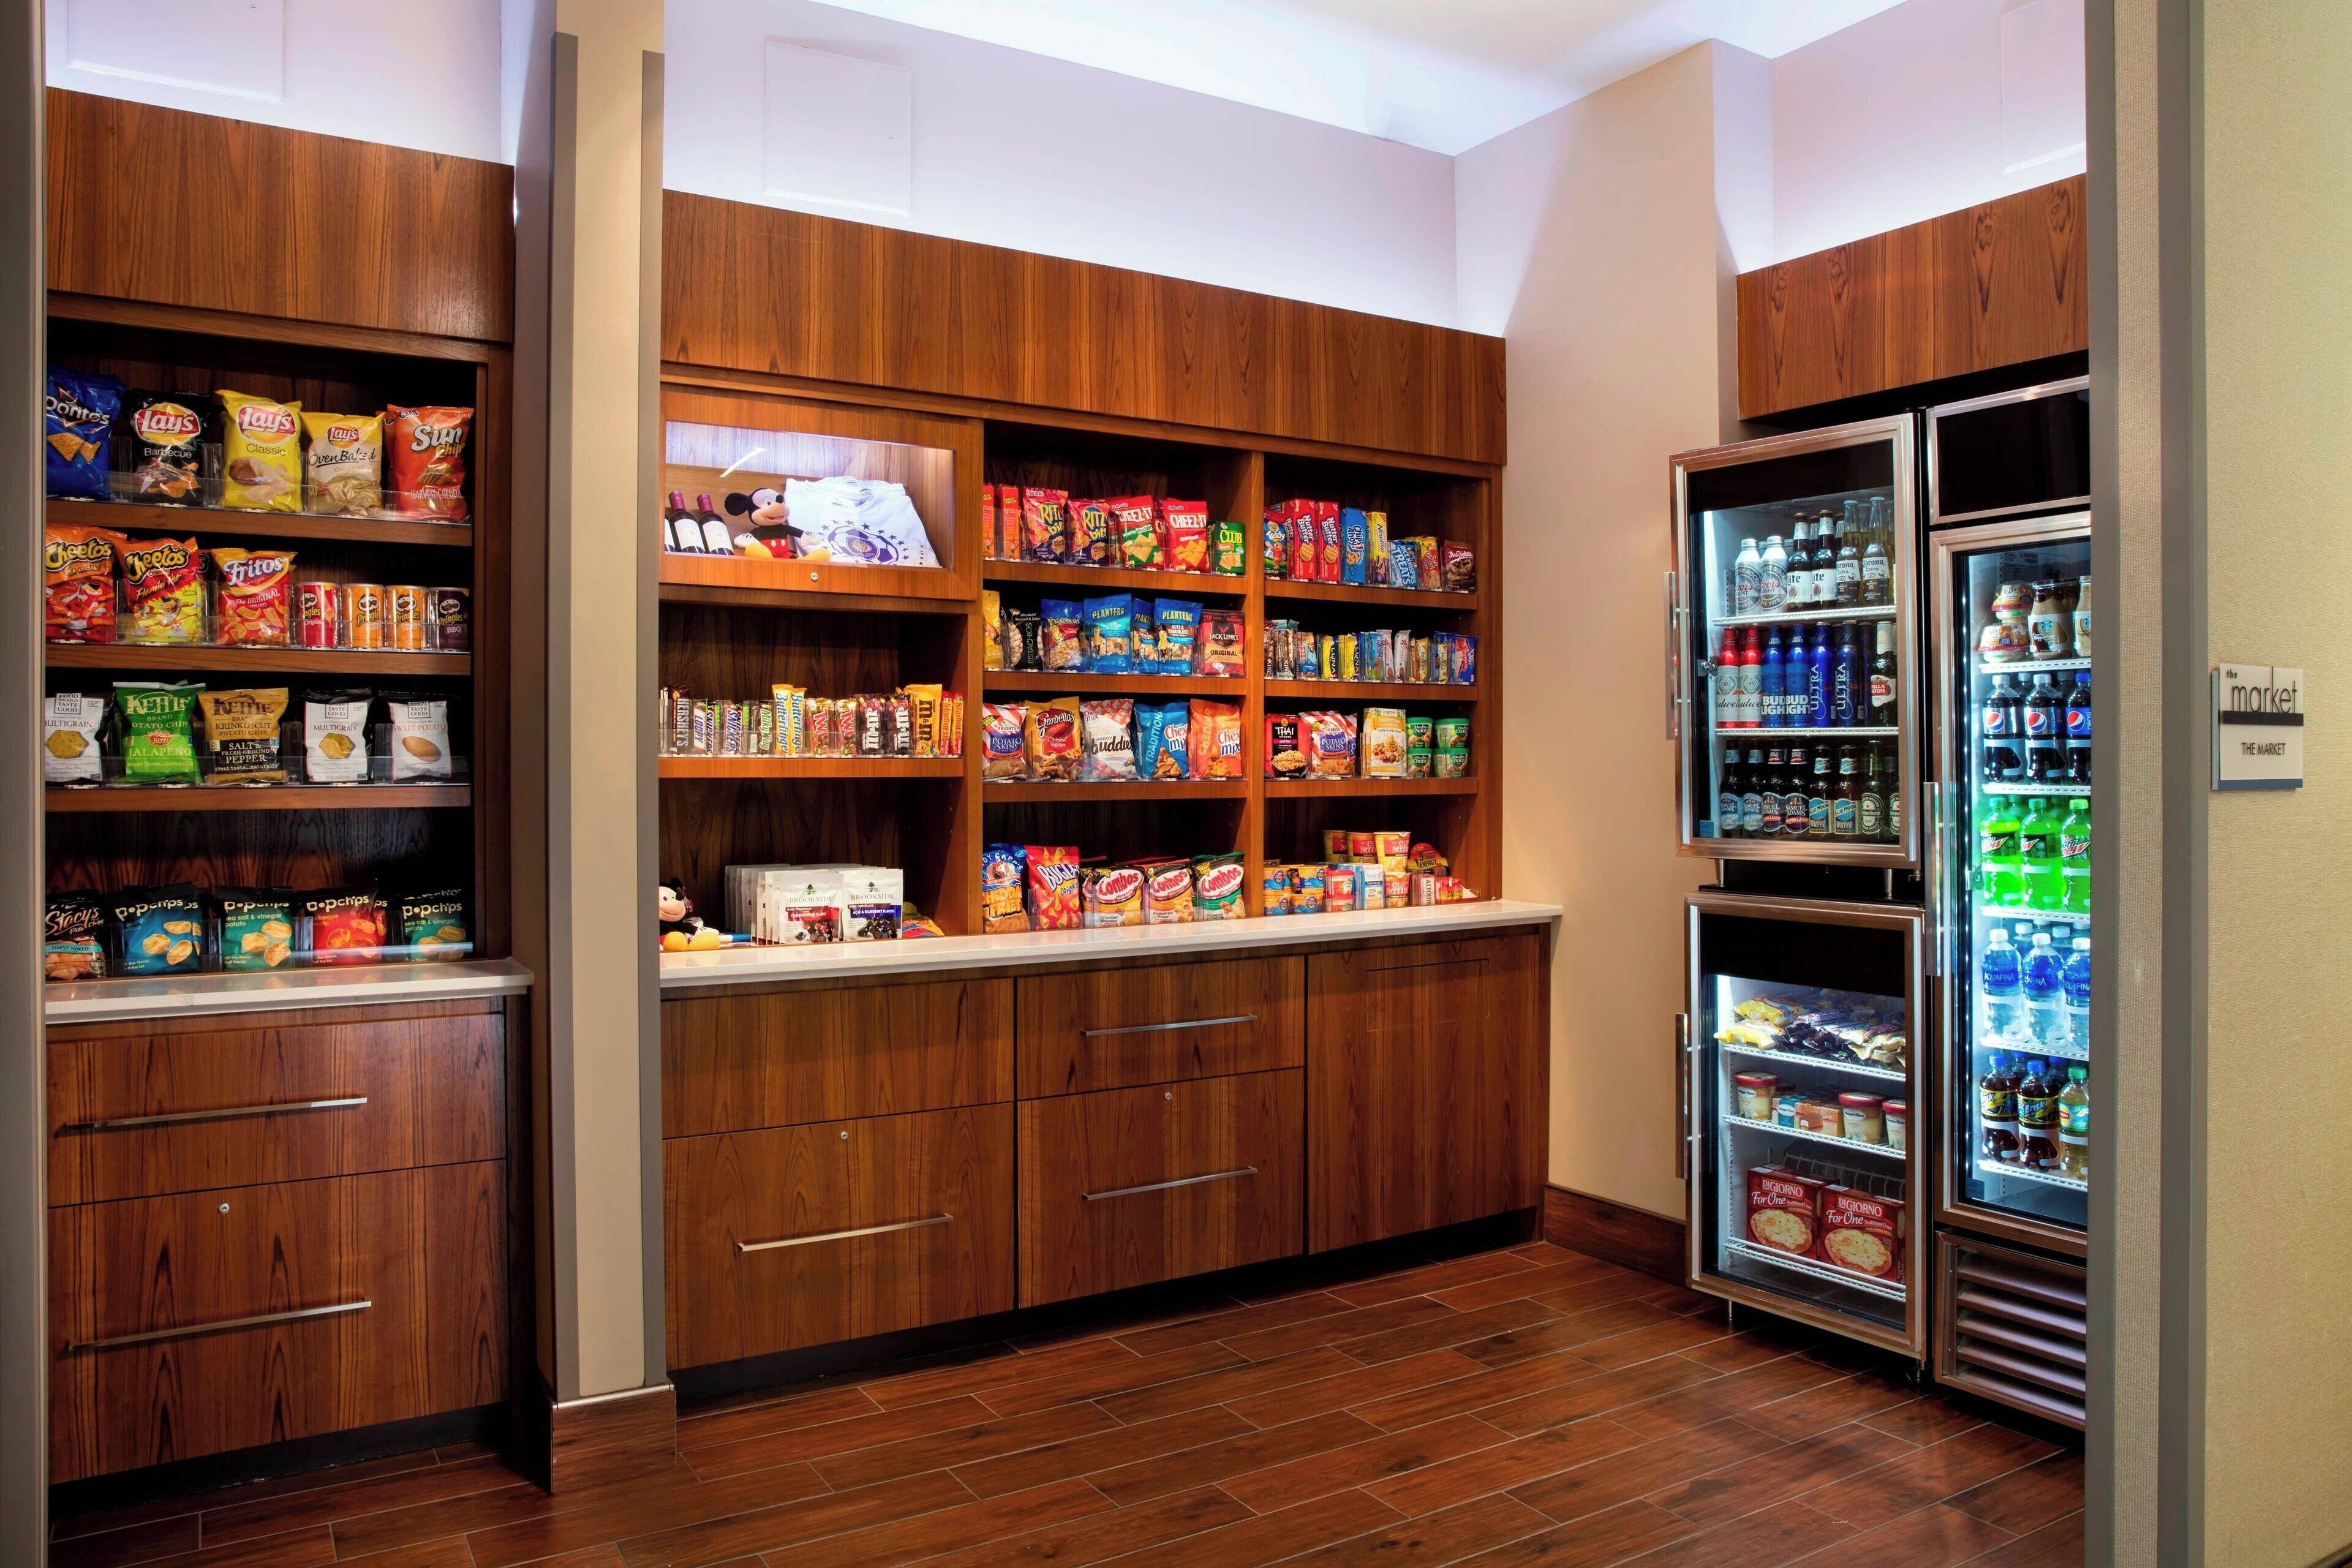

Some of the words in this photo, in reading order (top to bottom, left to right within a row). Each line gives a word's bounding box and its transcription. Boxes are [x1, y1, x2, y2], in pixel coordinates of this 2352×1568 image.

[46, 395, 110, 425] Doritos
[410, 424, 464, 452] Sun
[144, 447, 192, 459] Barbecue
[246, 443, 286, 456] Classic
[308, 452, 339, 466] Oven
[1039, 504, 1063, 524] RITZ
[1082, 510, 1107, 531] RITZ
[1169, 513, 1207, 529] CHEEZ-IT
[1265, 530, 1286, 541] Teddy
[1297, 518, 1310, 545] Butter
[1303, 513, 1314, 541] Nutter
[1321, 521, 1334, 546] Butter
[1327, 516, 1338, 544] Nutter
[1219, 530, 1243, 544] CLUB
[1376, 523, 1385, 554] Newtons
[46, 540, 114, 568] Cheetos
[64, 562, 101, 576] Crunchy
[126, 546, 188, 582] Cheetos
[223, 557, 284, 586] Fritos
[1393, 546, 1411, 586] TREATS
[1404, 557, 1416, 584] KRISPIES
[1863, 559, 1884, 568] Corona
[1787, 575, 1801, 586] Lite
[247, 588, 281, 605] ORIGINAL
[1091, 607, 1125, 619] PLANTERS
[1162, 611, 1193, 622] PLANTERS
[446, 625, 462, 634] BBQ
[2226, 669, 2237, 679] the
[1810, 663, 1819, 710] ULTRA
[1837, 662, 1846, 710] ULTRA
[2231, 666, 2297, 714] market
[124, 695, 191, 715] KETTLE
[212, 698, 274, 716] KETTLE
[1763, 696, 1785, 706] BUD
[1785, 695, 1809, 705] BUD
[676, 698, 690, 747] HERSHEY'S
[725, 707, 738, 754] SNICKERS
[775, 692, 790, 752] Butterfinge
[1164, 724, 1188, 739] Chex
[1217, 731, 1240, 744] Chex
[1275, 726, 1294, 736] THAI
[229, 741, 254, 750] SALT
[992, 736, 1022, 745] POTATO
[2241, 742, 2255, 755] THE
[2257, 742, 2286, 756] MARKET
[1221, 742, 1240, 757] mix
[225, 754, 268, 764] PEPPER
[1419, 859, 1437, 868] ENERGY
[1098, 872, 1139, 895] Combos
[1152, 869, 1188, 893] Combos
[1202, 867, 1242, 893] Combos
[306, 895, 370, 912] popchips
[402, 902, 462, 919] popchips
[45, 907, 100, 935] Stacy's
[1984, 971, 2015, 981] AQUAFINA
[1751, 1191, 1768, 1206] For
[1767, 1192, 1787, 1205] One
[1826, 1210, 1844, 1224] For
[1844, 1211, 1864, 1224] One
